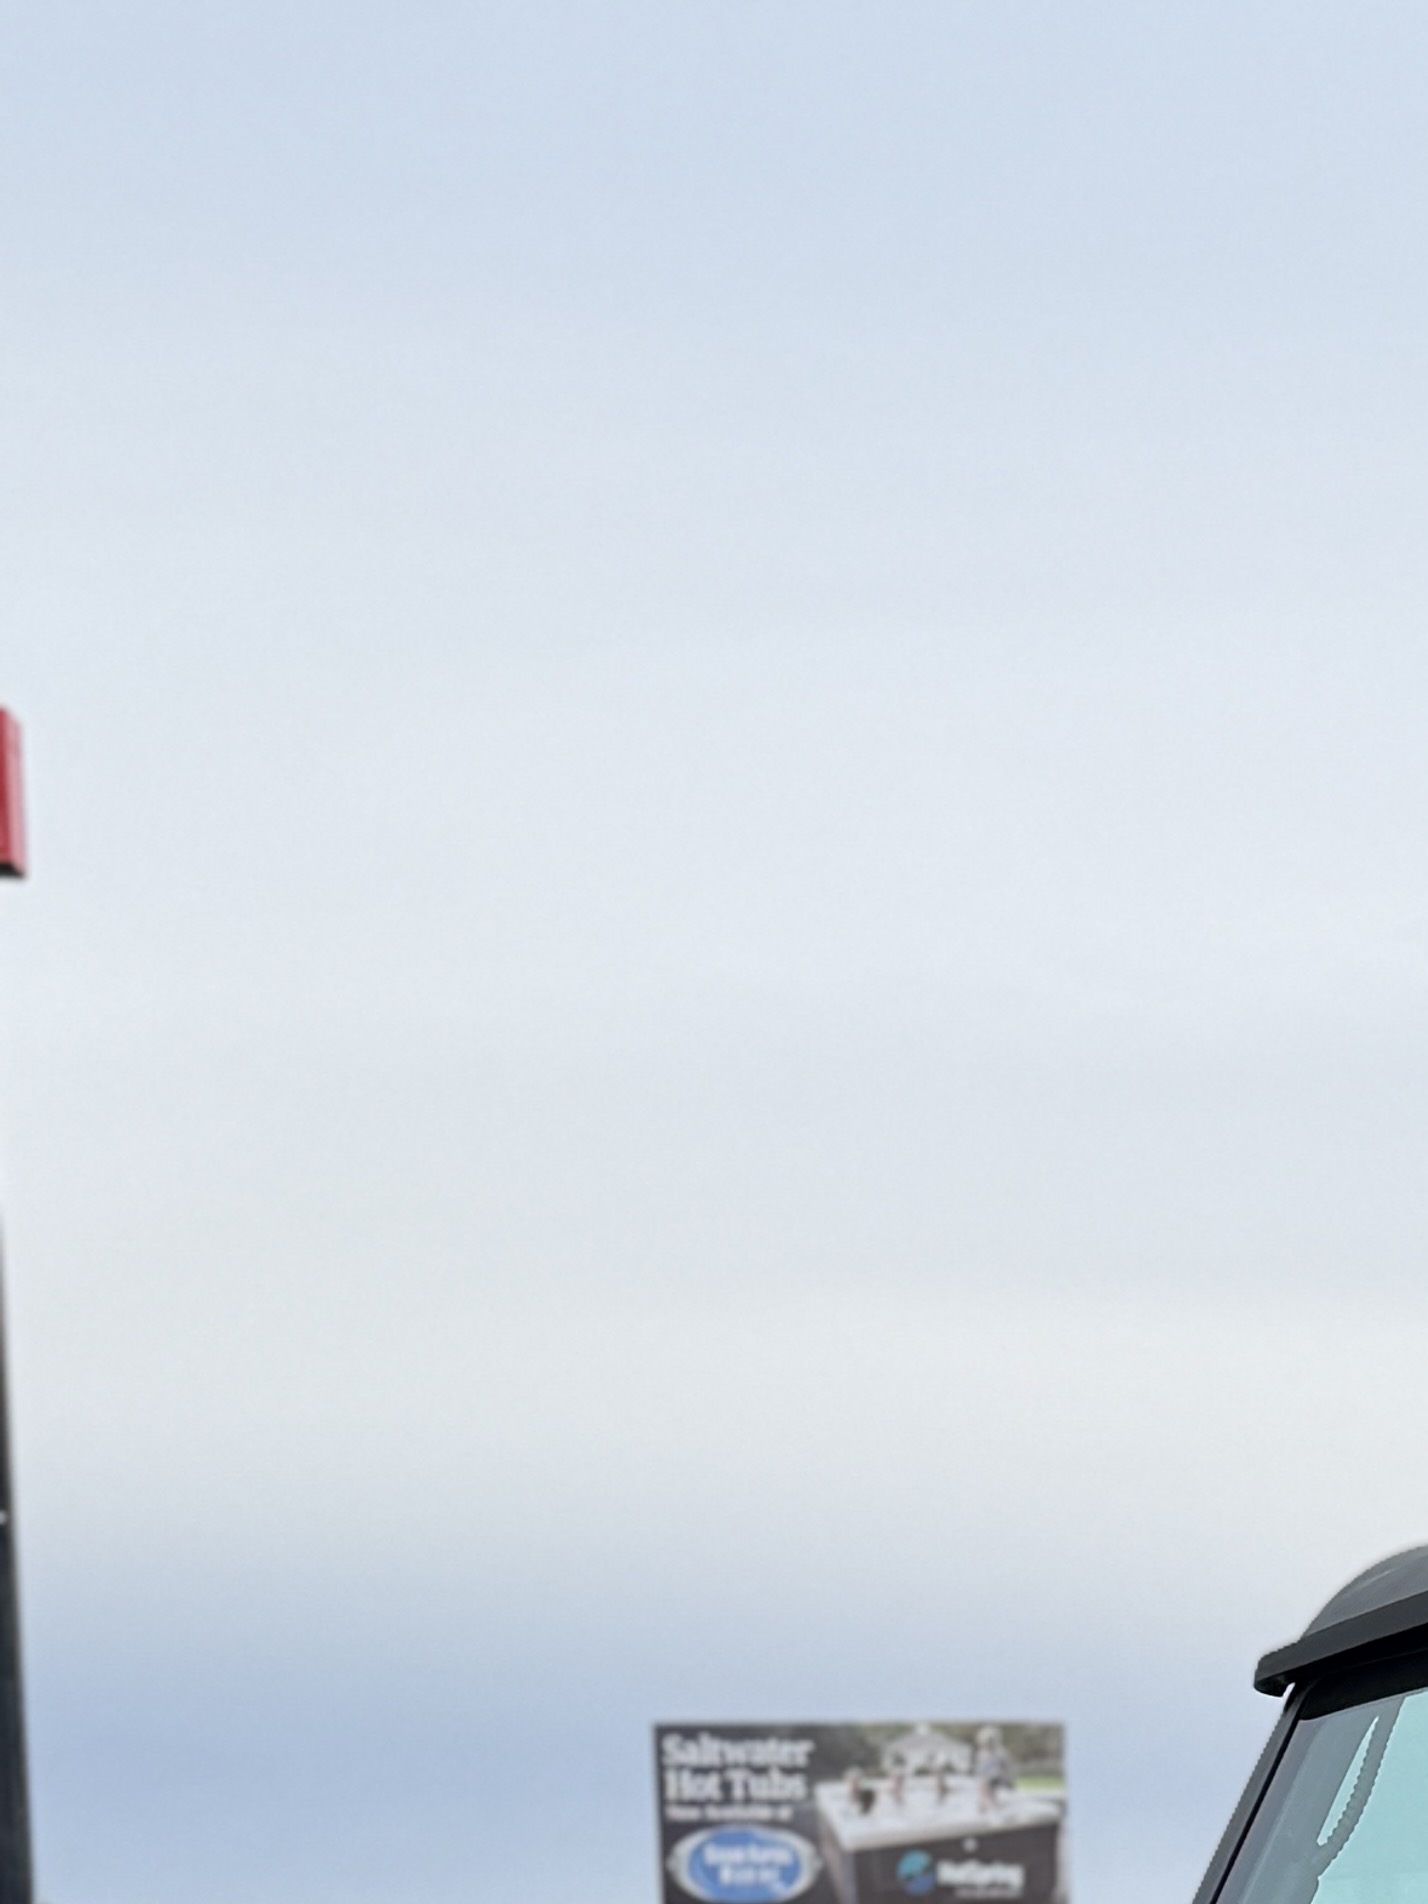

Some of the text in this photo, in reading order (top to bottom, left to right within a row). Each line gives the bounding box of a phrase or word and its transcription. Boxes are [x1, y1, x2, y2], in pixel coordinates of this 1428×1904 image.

[662, 1732, 814, 1767] Saltwater
[665, 1767, 806, 1801] Hot Tubs
